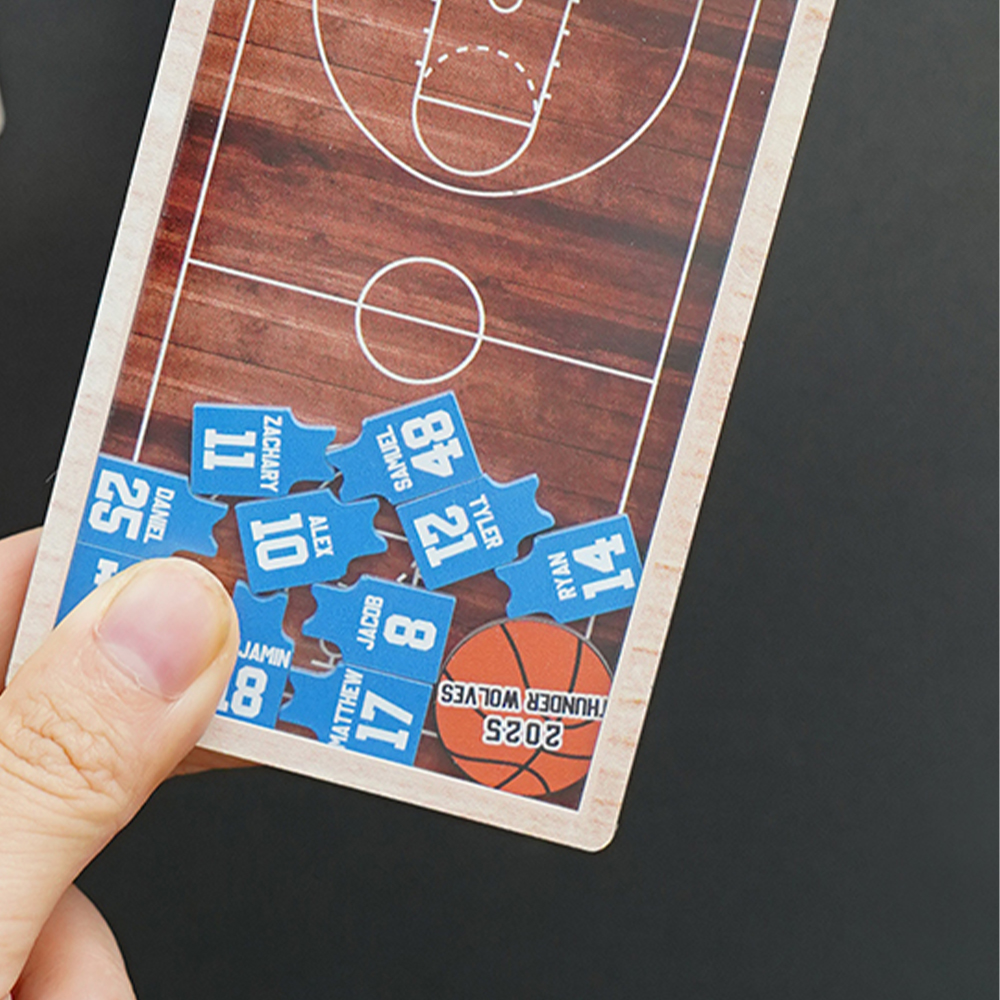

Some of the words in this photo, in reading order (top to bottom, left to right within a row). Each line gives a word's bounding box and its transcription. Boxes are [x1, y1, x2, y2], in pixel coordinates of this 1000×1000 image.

[202, 428, 257, 470] 11
[260, 414, 283, 493] ZACHARY
[375, 424, 413, 492] SAMUEL
[400, 409, 464, 478] 48
[88, 469, 150, 541] 25
[143, 486, 175, 544] DANIEL
[468, 493, 504, 550] TYLER
[250, 512, 310, 572] 10
[308, 514, 334, 558] ALEX
[413, 504, 478, 569] 21
[547, 551, 577, 601] RYAN
[572, 533, 636, 600] 14
[356, 594, 384, 651] JACOB
[383, 613, 437, 652] 8
[237, 640, 292, 669] JAMIN
[329, 668, 364, 749] MATTHEW
[355, 689, 414, 751] 17
[441, 683, 520, 710] WOLVES
[485, 717, 562, 748] 2025
